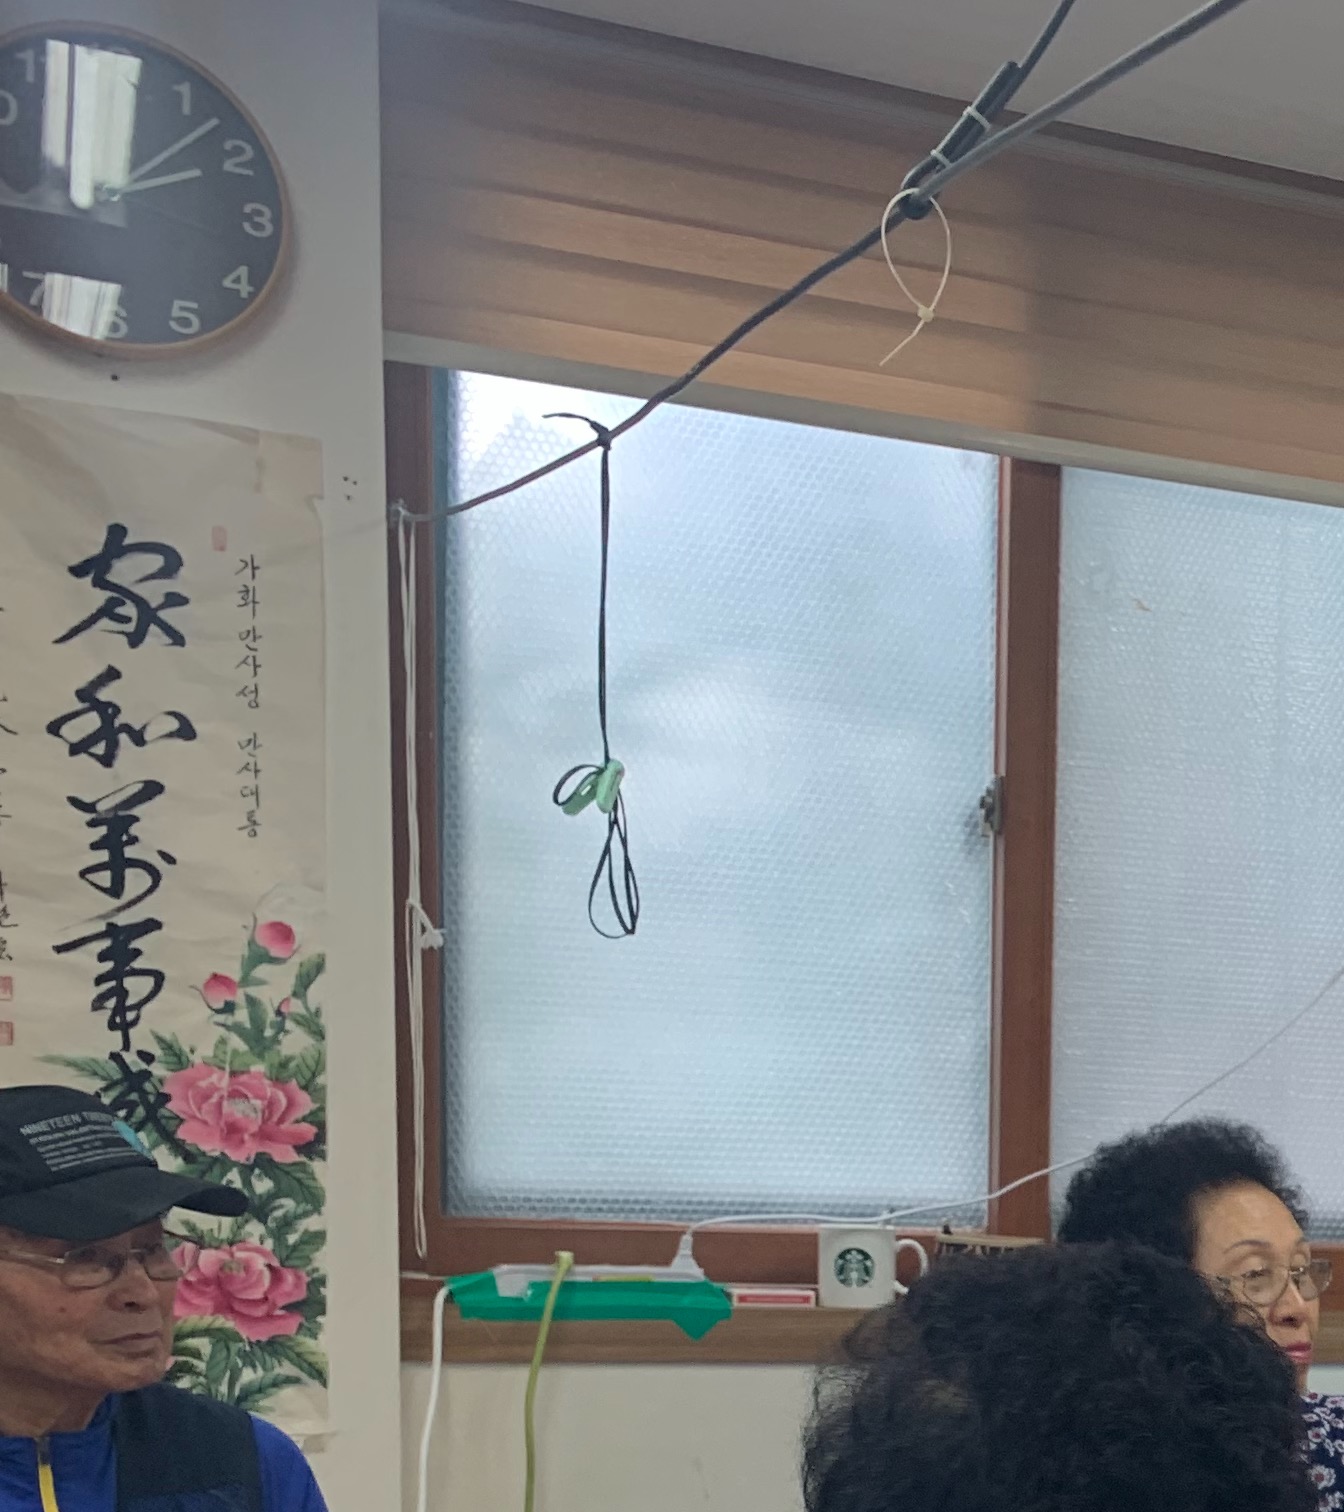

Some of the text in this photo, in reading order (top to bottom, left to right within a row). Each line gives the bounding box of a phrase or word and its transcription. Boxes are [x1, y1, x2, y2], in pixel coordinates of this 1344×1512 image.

[172, 81, 192, 116] 1
[222, 139, 255, 176] 2
[242, 203, 274, 238] 3
[222, 265, 254, 298] 4
[168, 300, 200, 334] 5
